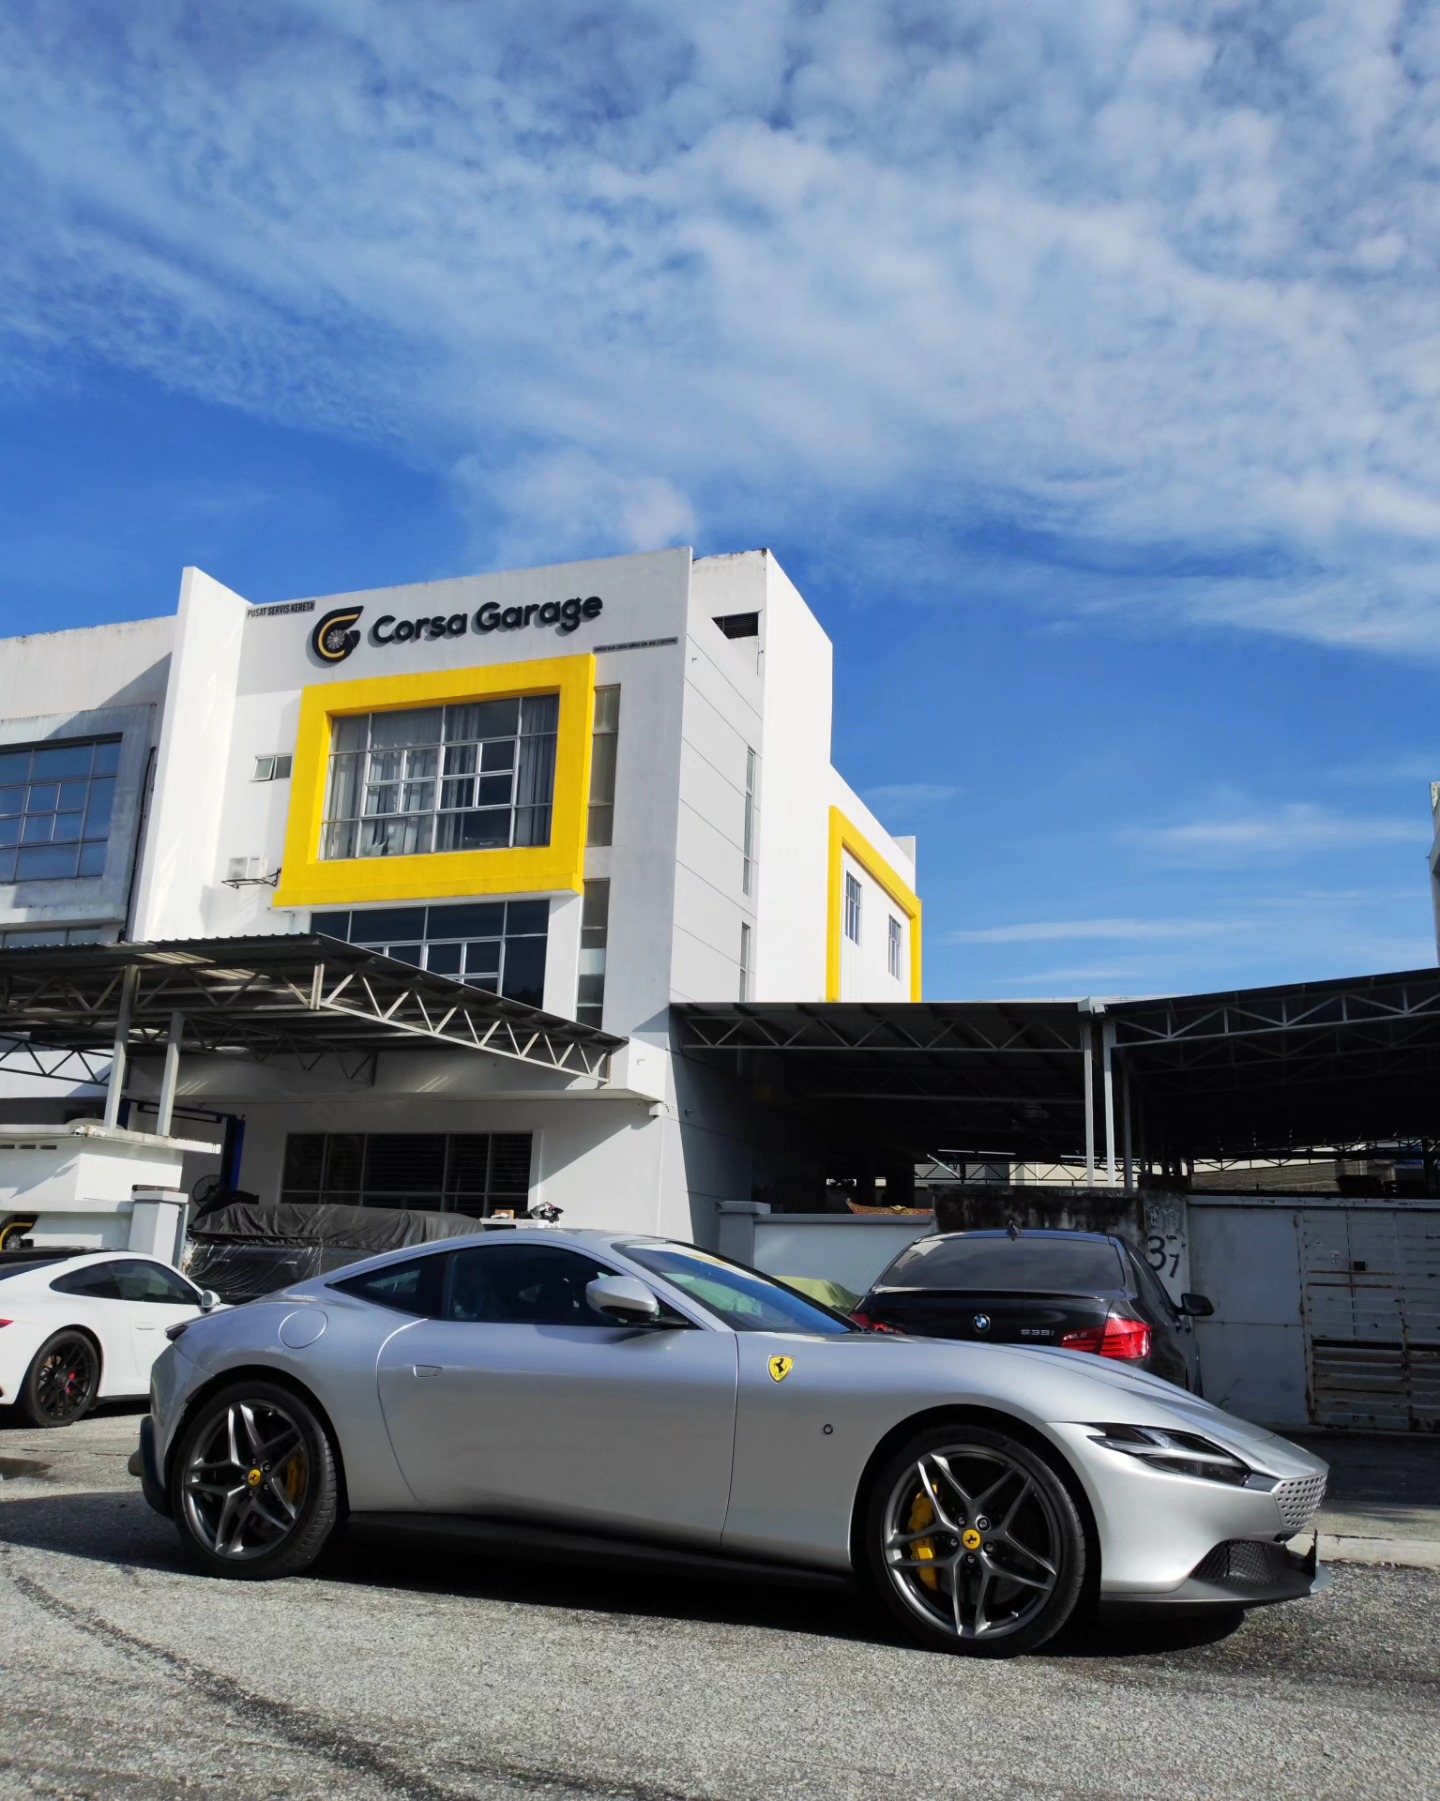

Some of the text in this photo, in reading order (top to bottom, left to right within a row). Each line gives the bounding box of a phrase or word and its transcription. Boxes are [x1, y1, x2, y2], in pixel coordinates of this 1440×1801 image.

[247, 601, 315, 618] PUSAT SERVIS KERETA
[373, 596, 604, 644] Corsa Garage
